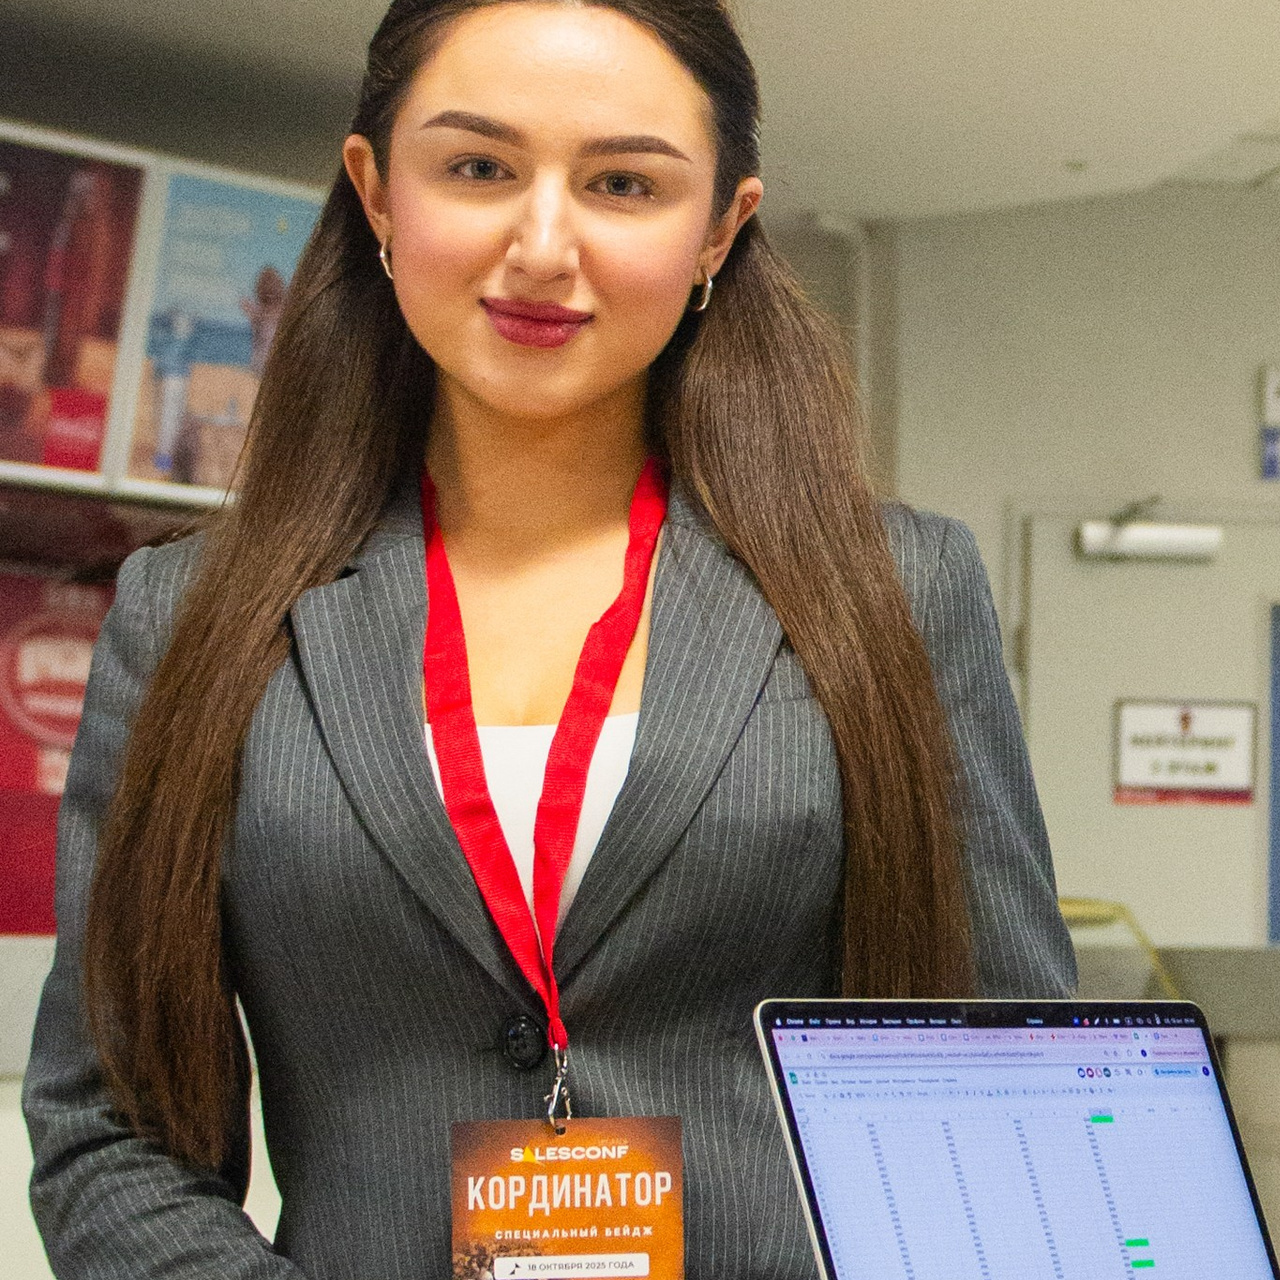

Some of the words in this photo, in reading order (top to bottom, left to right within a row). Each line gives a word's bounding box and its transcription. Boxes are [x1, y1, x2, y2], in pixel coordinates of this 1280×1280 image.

[467, 1171, 672, 1217] КОРДИНАТОР
[495, 1226, 598, 1241] СПЕЦИАЛЬНЫЙ
[605, 1224, 654, 1238] БЕЙДЖ
[539, 1262, 583, 1271] ОКТЯБРЯ
[608, 1260, 635, 1270] ГОДА
